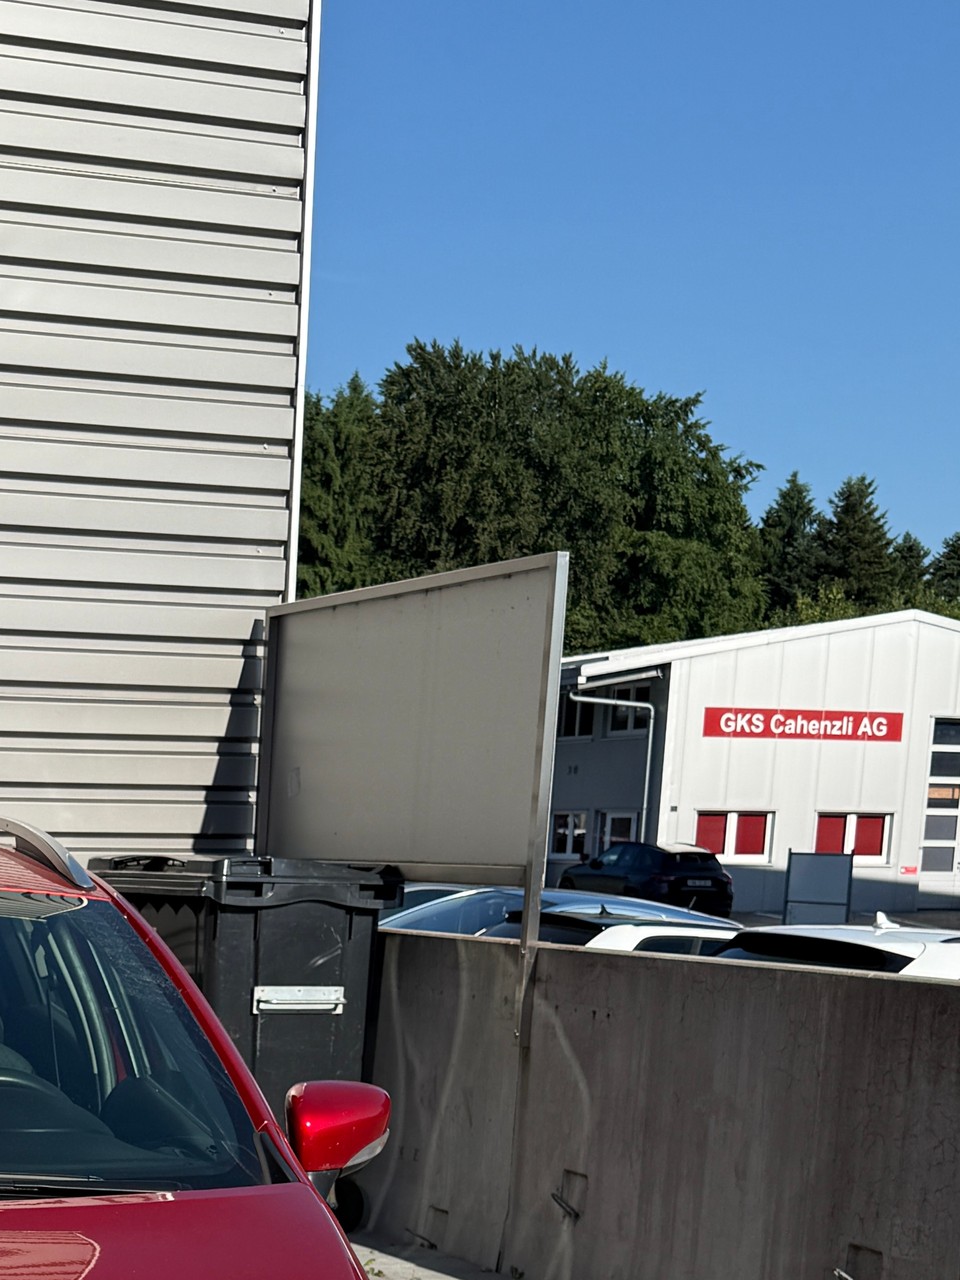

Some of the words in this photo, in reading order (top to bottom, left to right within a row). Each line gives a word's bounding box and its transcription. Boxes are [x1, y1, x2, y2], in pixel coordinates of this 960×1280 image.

[720, 712, 765, 733] GKS
[770, 713, 853, 736] Cahenzli
[857, 717, 888, 737] AG
